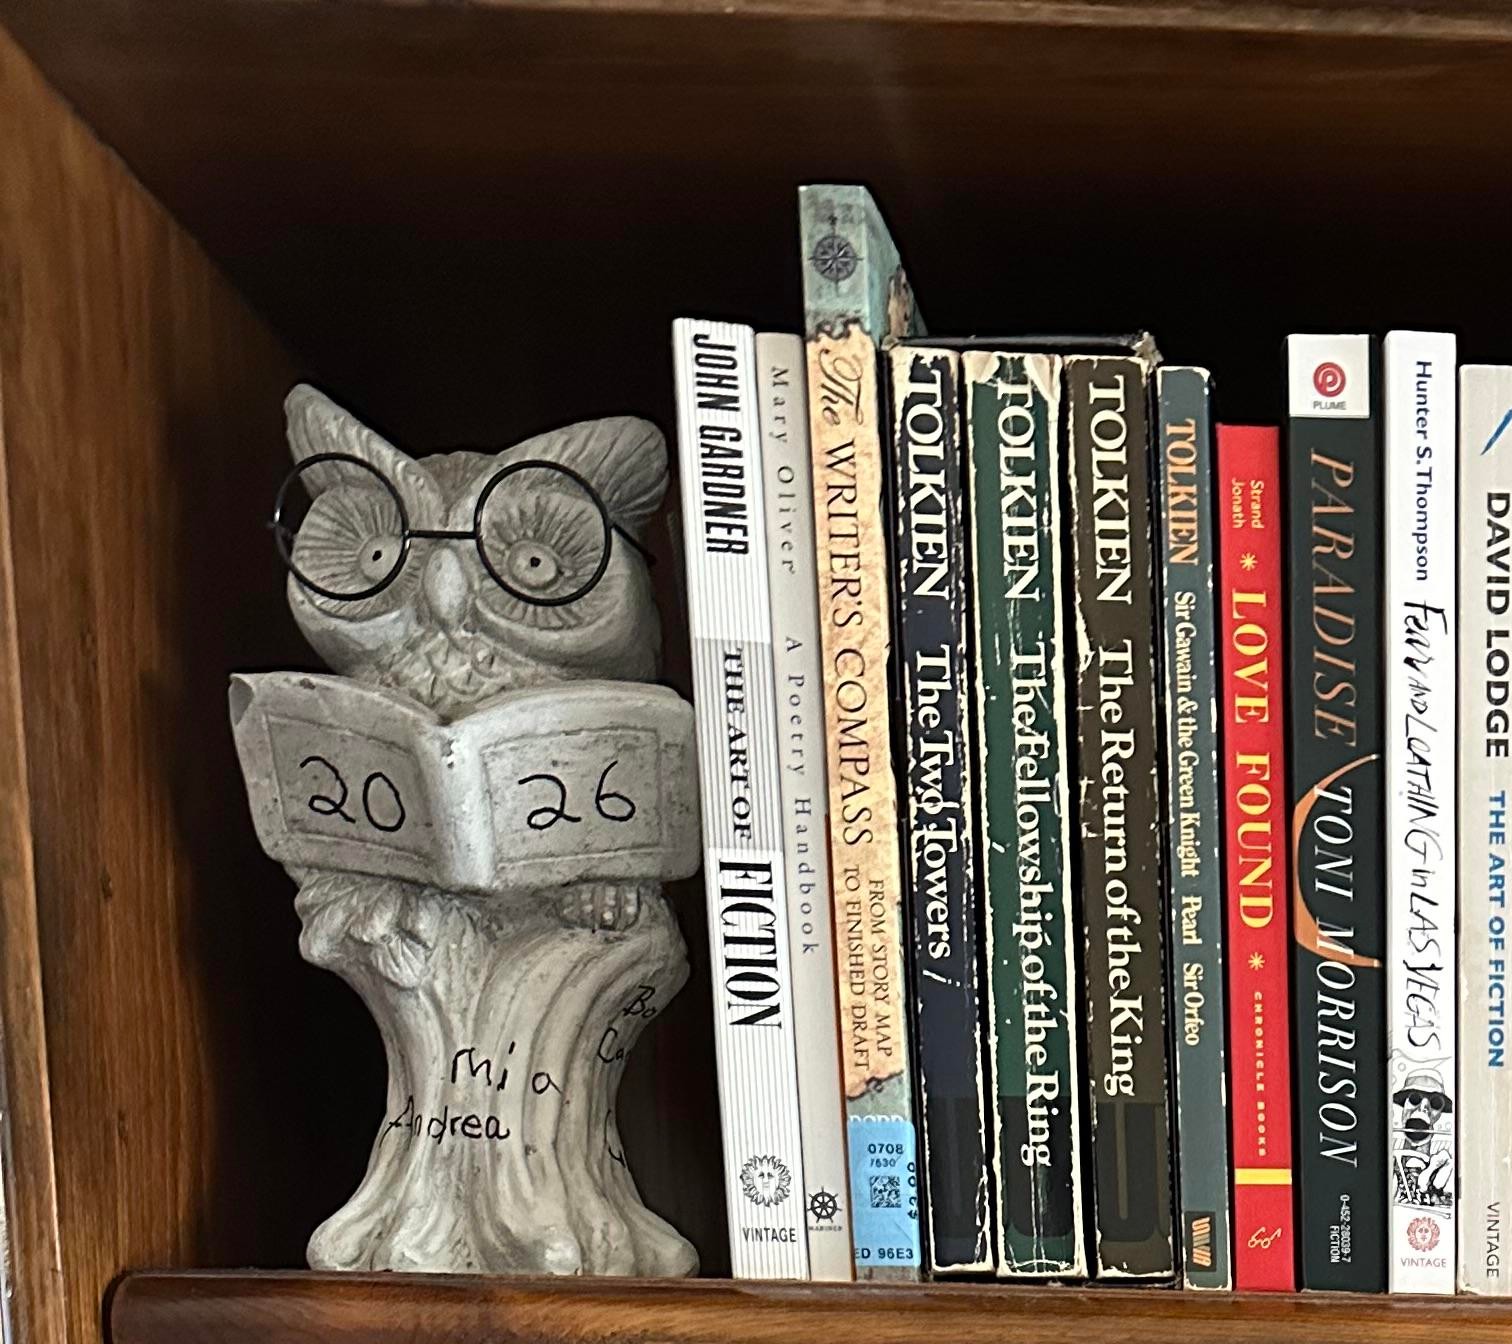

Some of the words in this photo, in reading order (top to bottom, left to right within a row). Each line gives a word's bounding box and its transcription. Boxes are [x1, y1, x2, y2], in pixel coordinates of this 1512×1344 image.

[693, 333, 740, 412] JOHN
[770, 366, 789, 445] Mary
[699, 425, 750, 556] GARDNER
[904, 369, 951, 600] TOLKIEN
[777, 466, 795, 575] Oliver
[1484, 491, 1511, 616] DAVID
[722, 648, 744, 714] THE
[1484, 631, 1510, 759] LODGE
[727, 722, 752, 788] ART
[732, 795, 752, 840] OF
[844, 866, 860, 892] TO
[868, 879, 886, 935] FROM
[719, 861, 782, 1030] FICTION
[844, 900, 865, 997] FINISHED
[871, 941, 889, 1011] STORY
[848, 1007, 871, 1070] DRAFT
[875, 1017, 893, 1057] MAP
[868, 1143, 904, 1155] 0708
[741, 1227, 797, 1243] VINTAGE
